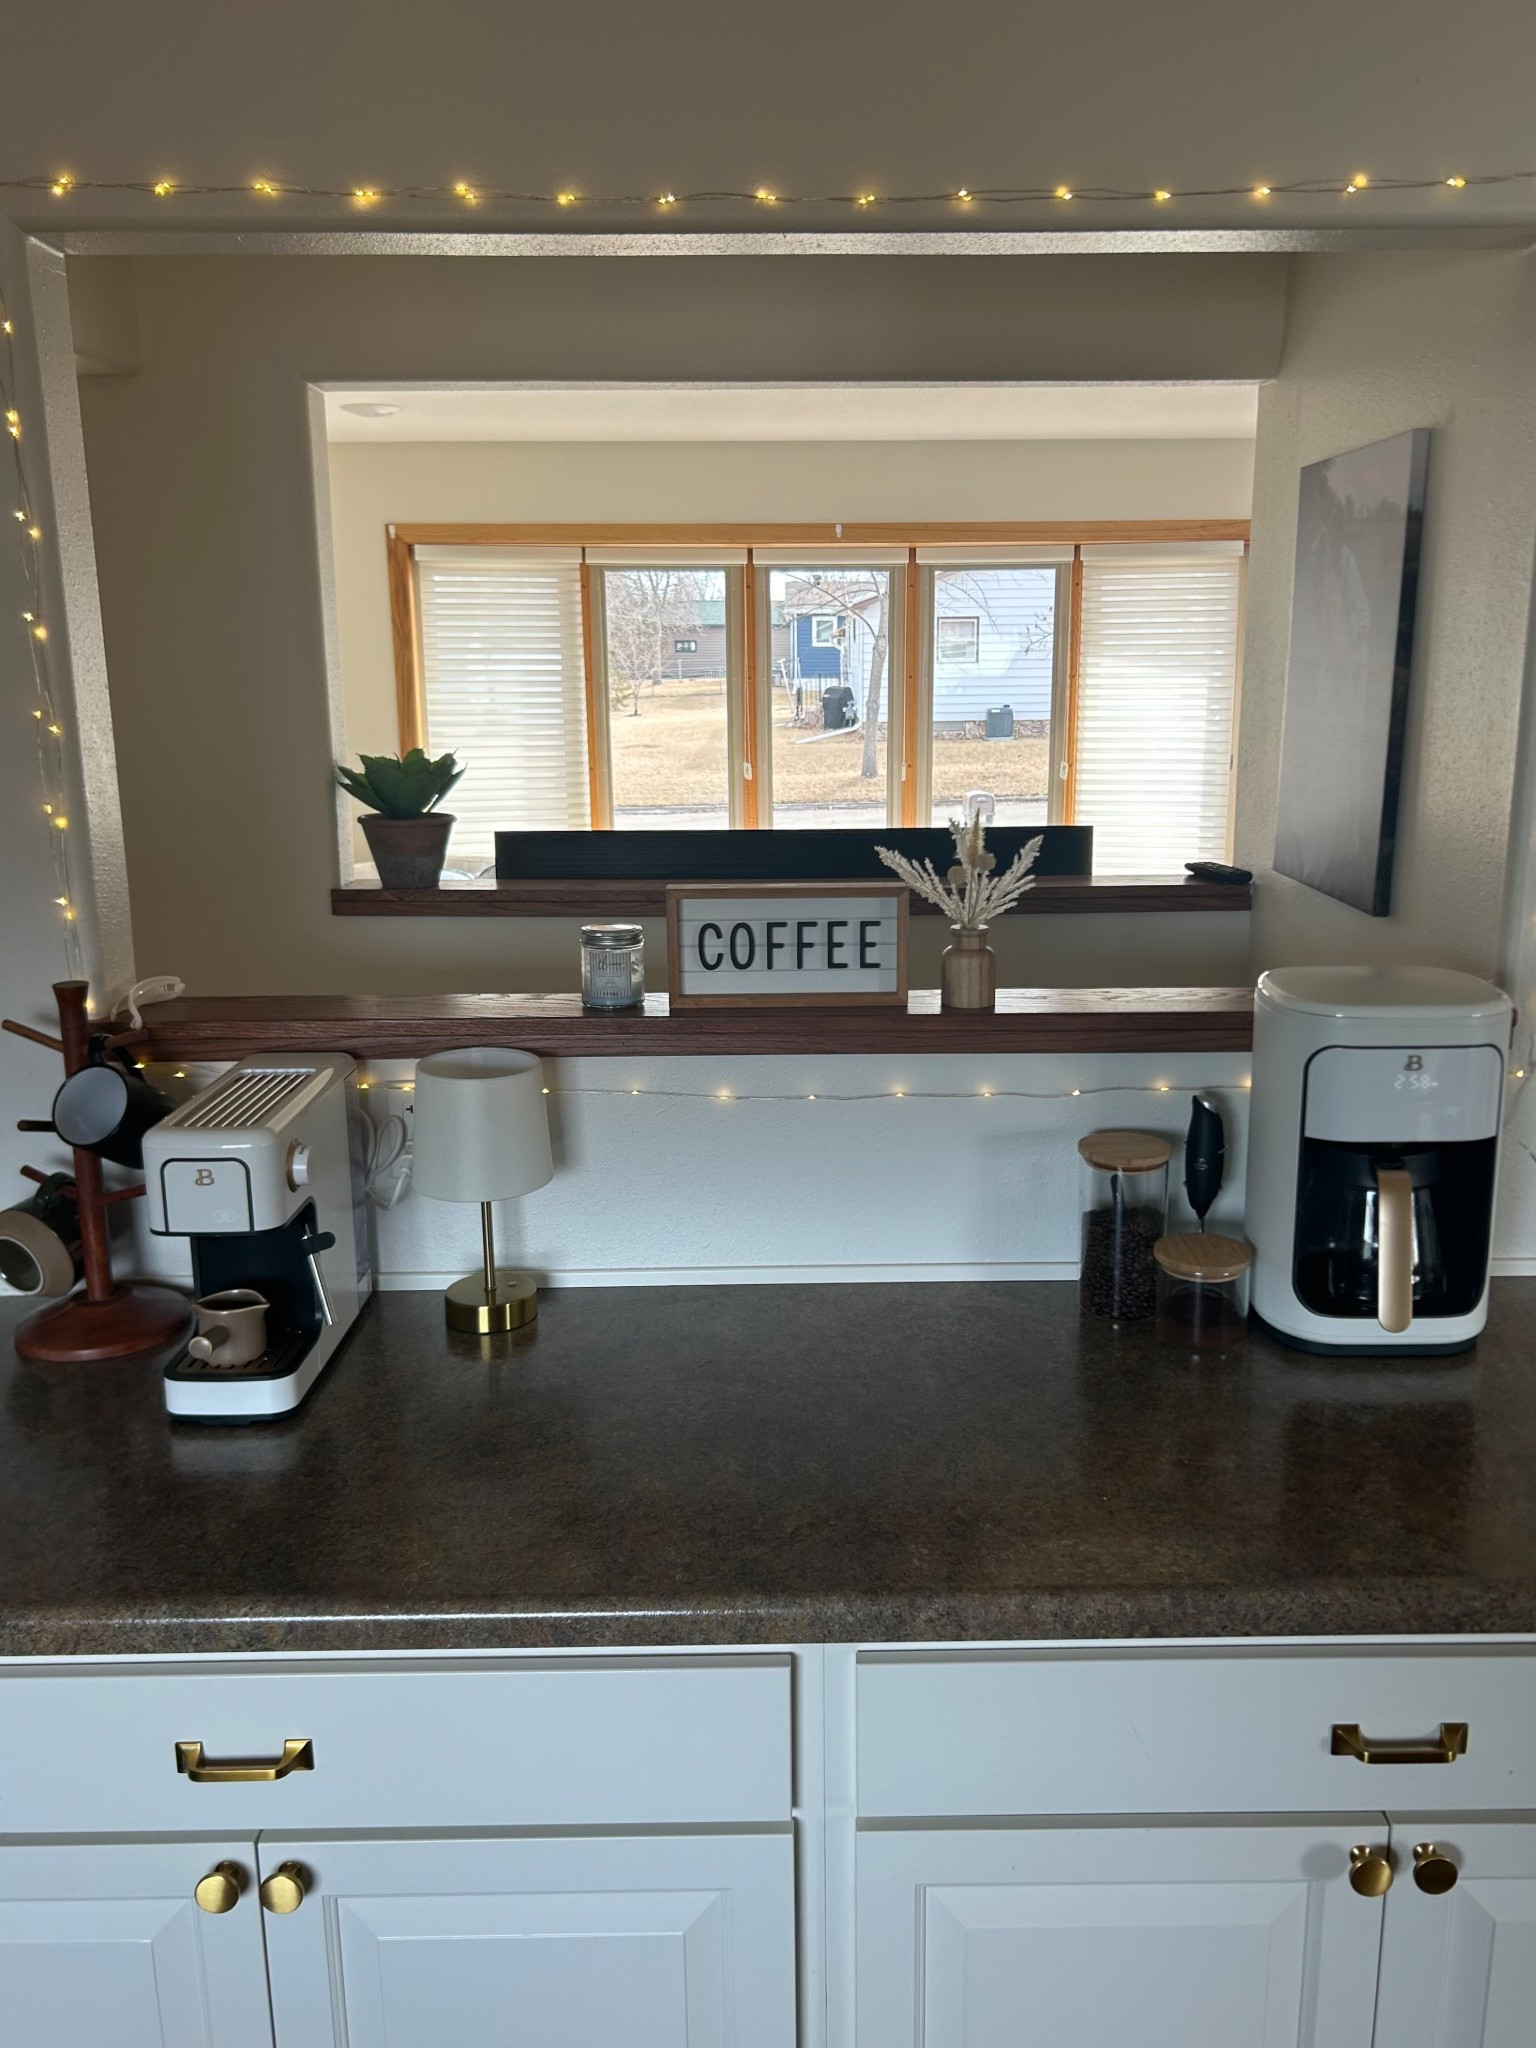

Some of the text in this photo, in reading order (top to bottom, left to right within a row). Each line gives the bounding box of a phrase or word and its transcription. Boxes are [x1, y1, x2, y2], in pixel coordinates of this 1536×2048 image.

[698, 920, 881, 970] COFFEE
[1403, 1054, 1424, 1072] B
[195, 1168, 215, 1186] B
